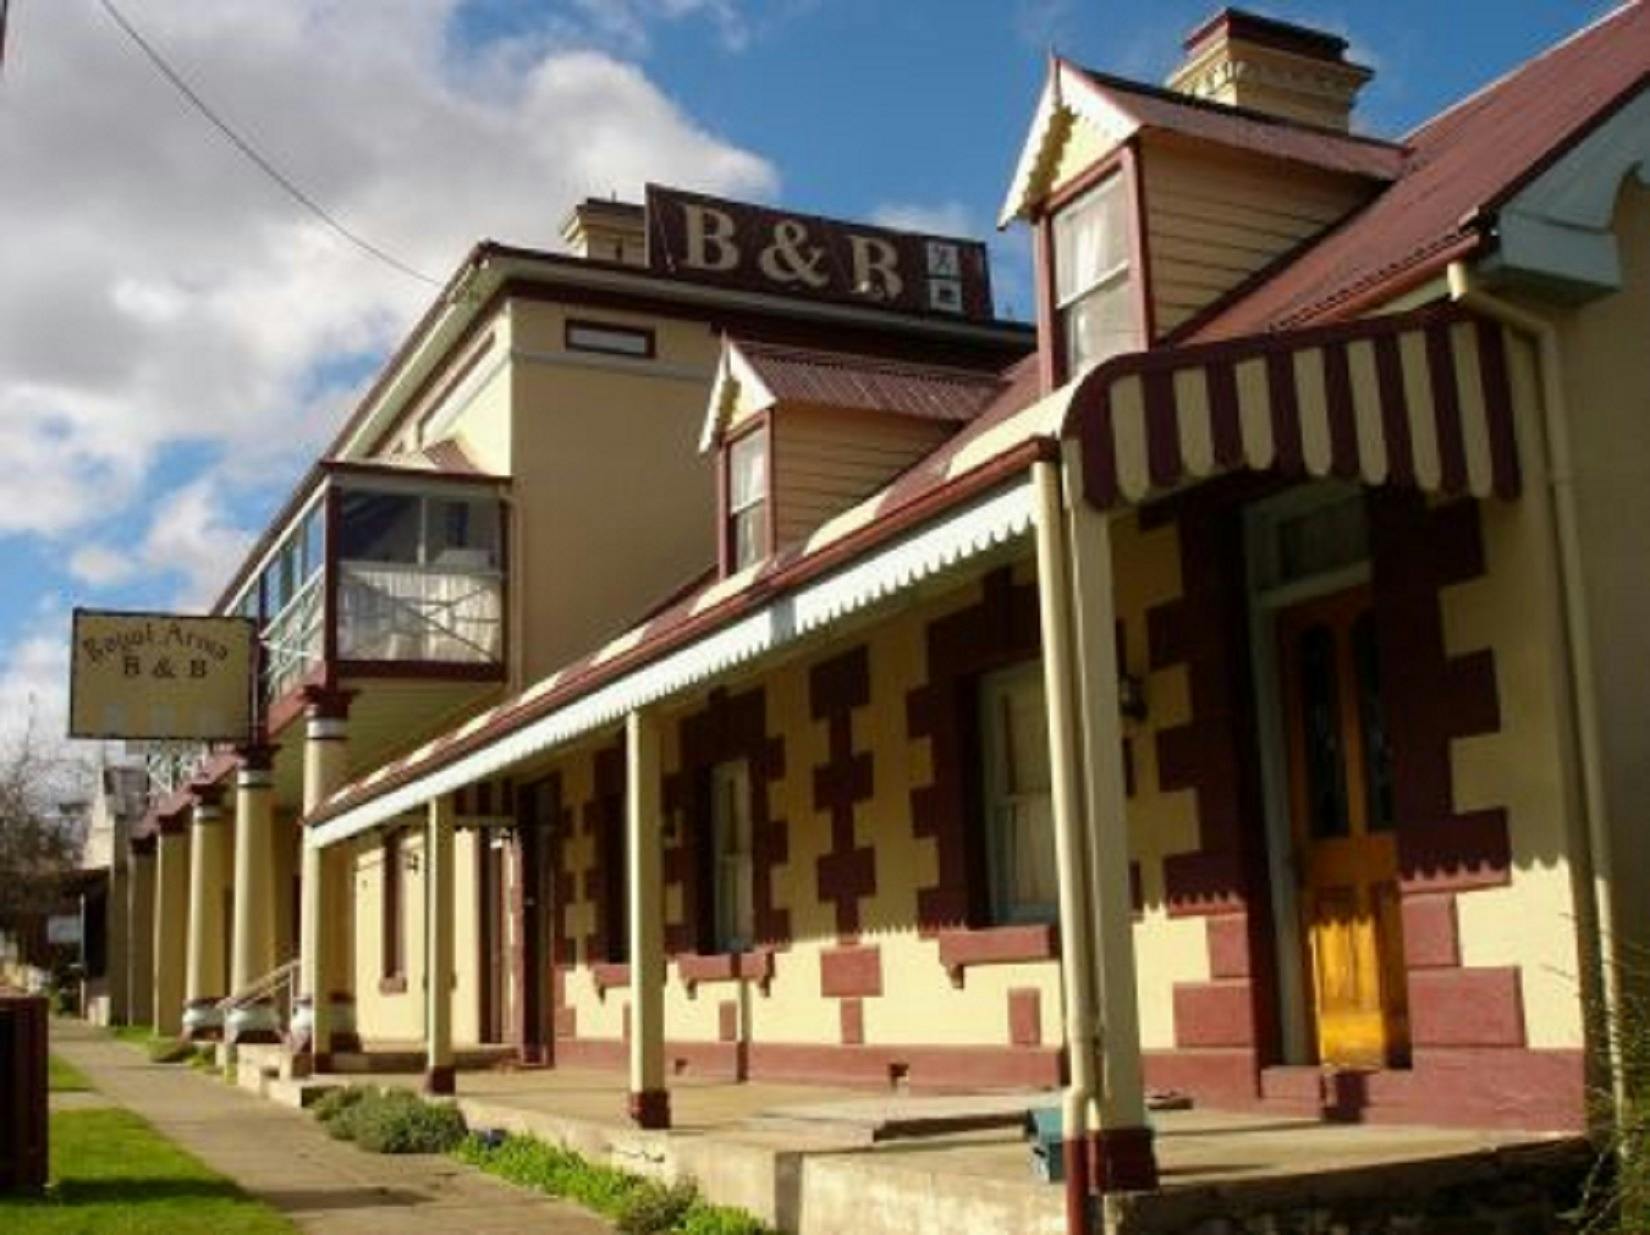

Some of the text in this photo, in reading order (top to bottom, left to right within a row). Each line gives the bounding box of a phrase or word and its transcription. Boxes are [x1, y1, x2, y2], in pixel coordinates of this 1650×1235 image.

[685, 204, 903, 301] B & B
[83, 622, 228, 661] Royal Arms
[123, 657, 207, 678] B & B
